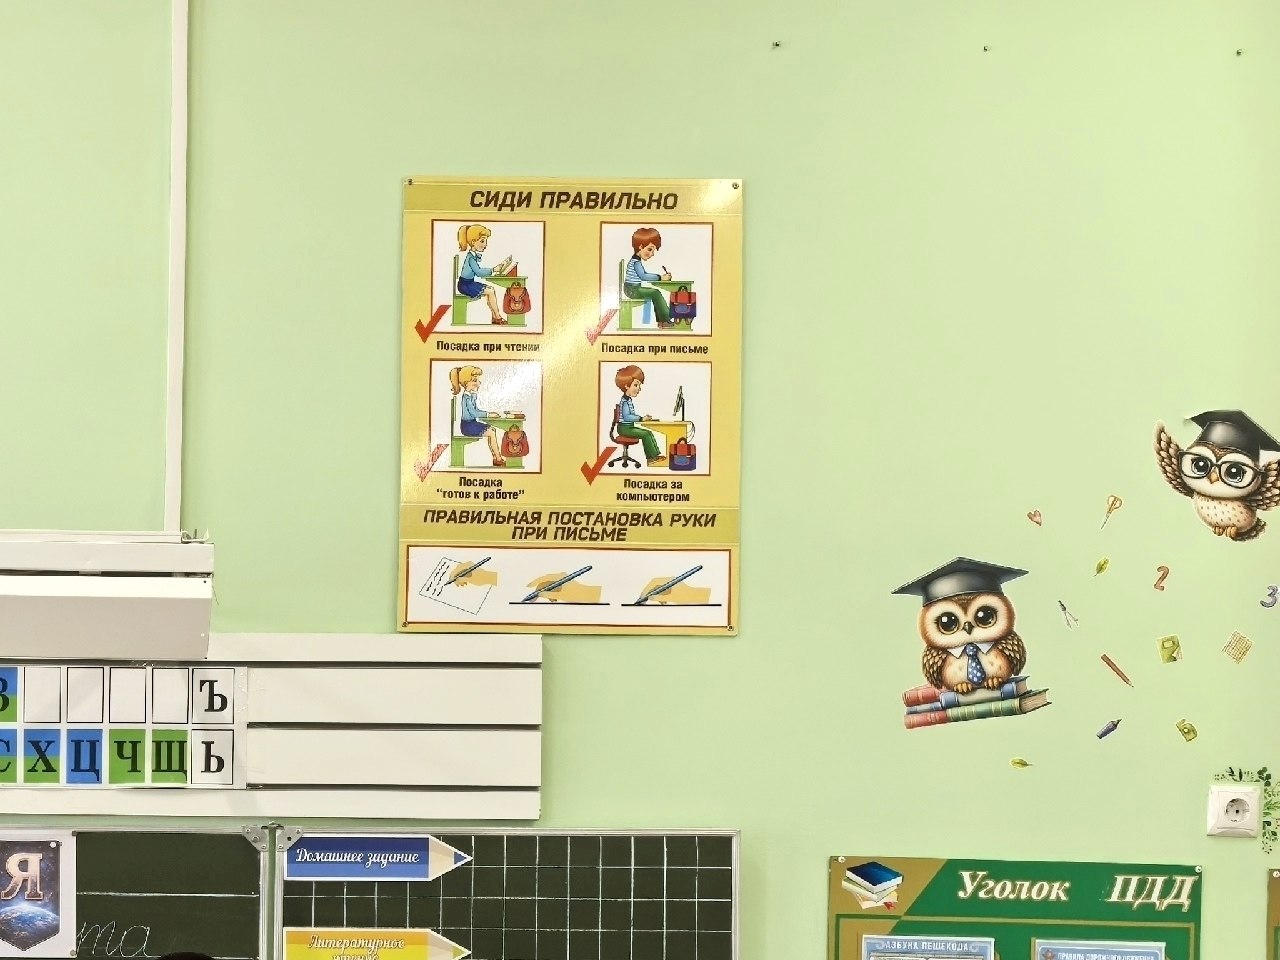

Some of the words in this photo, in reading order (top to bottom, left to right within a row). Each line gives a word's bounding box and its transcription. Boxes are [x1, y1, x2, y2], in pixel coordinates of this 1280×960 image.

[470, 190, 532, 211] СИДИ
[540, 191, 678, 211] ПРАВИЛЬНО
[436, 340, 481, 353] Посадка
[484, 341, 503, 354] при
[505, 342, 540, 353] чтении
[601, 342, 646, 355] Посадка
[648, 344, 667, 356] при
[669, 344, 709, 355] письме
[458, 476, 503, 489] Посадка
[624, 478, 668, 490] Посадка
[671, 480, 683, 490] за
[474, 490, 480, 500] к
[616, 491, 690, 504] компьютером
[423, 510, 542, 525] ПРАВИЛЬНАЯ
[548, 511, 664, 527] ПОСТАНОВКА
[669, 513, 717, 528] РУКИ
[511, 526, 548, 541] ПРИ
[554, 527, 628, 542] ПИСЬМЕ
[199, 679, 228, 713] Ъ
[28, 739, 55, 772] Х
[70, 740, 100, 781] Ц
[114, 741, 142, 773] Ч
[151, 741, 187, 781] Щ
[200, 742, 225, 774] Ь
[296, 848, 364, 862] Домашнее
[365, 851, 420, 868] задание
[958, 871, 1071, 901] Уголок
[1105, 874, 1199, 912] ПДД
[308, 934, 406, 955] Литературное
